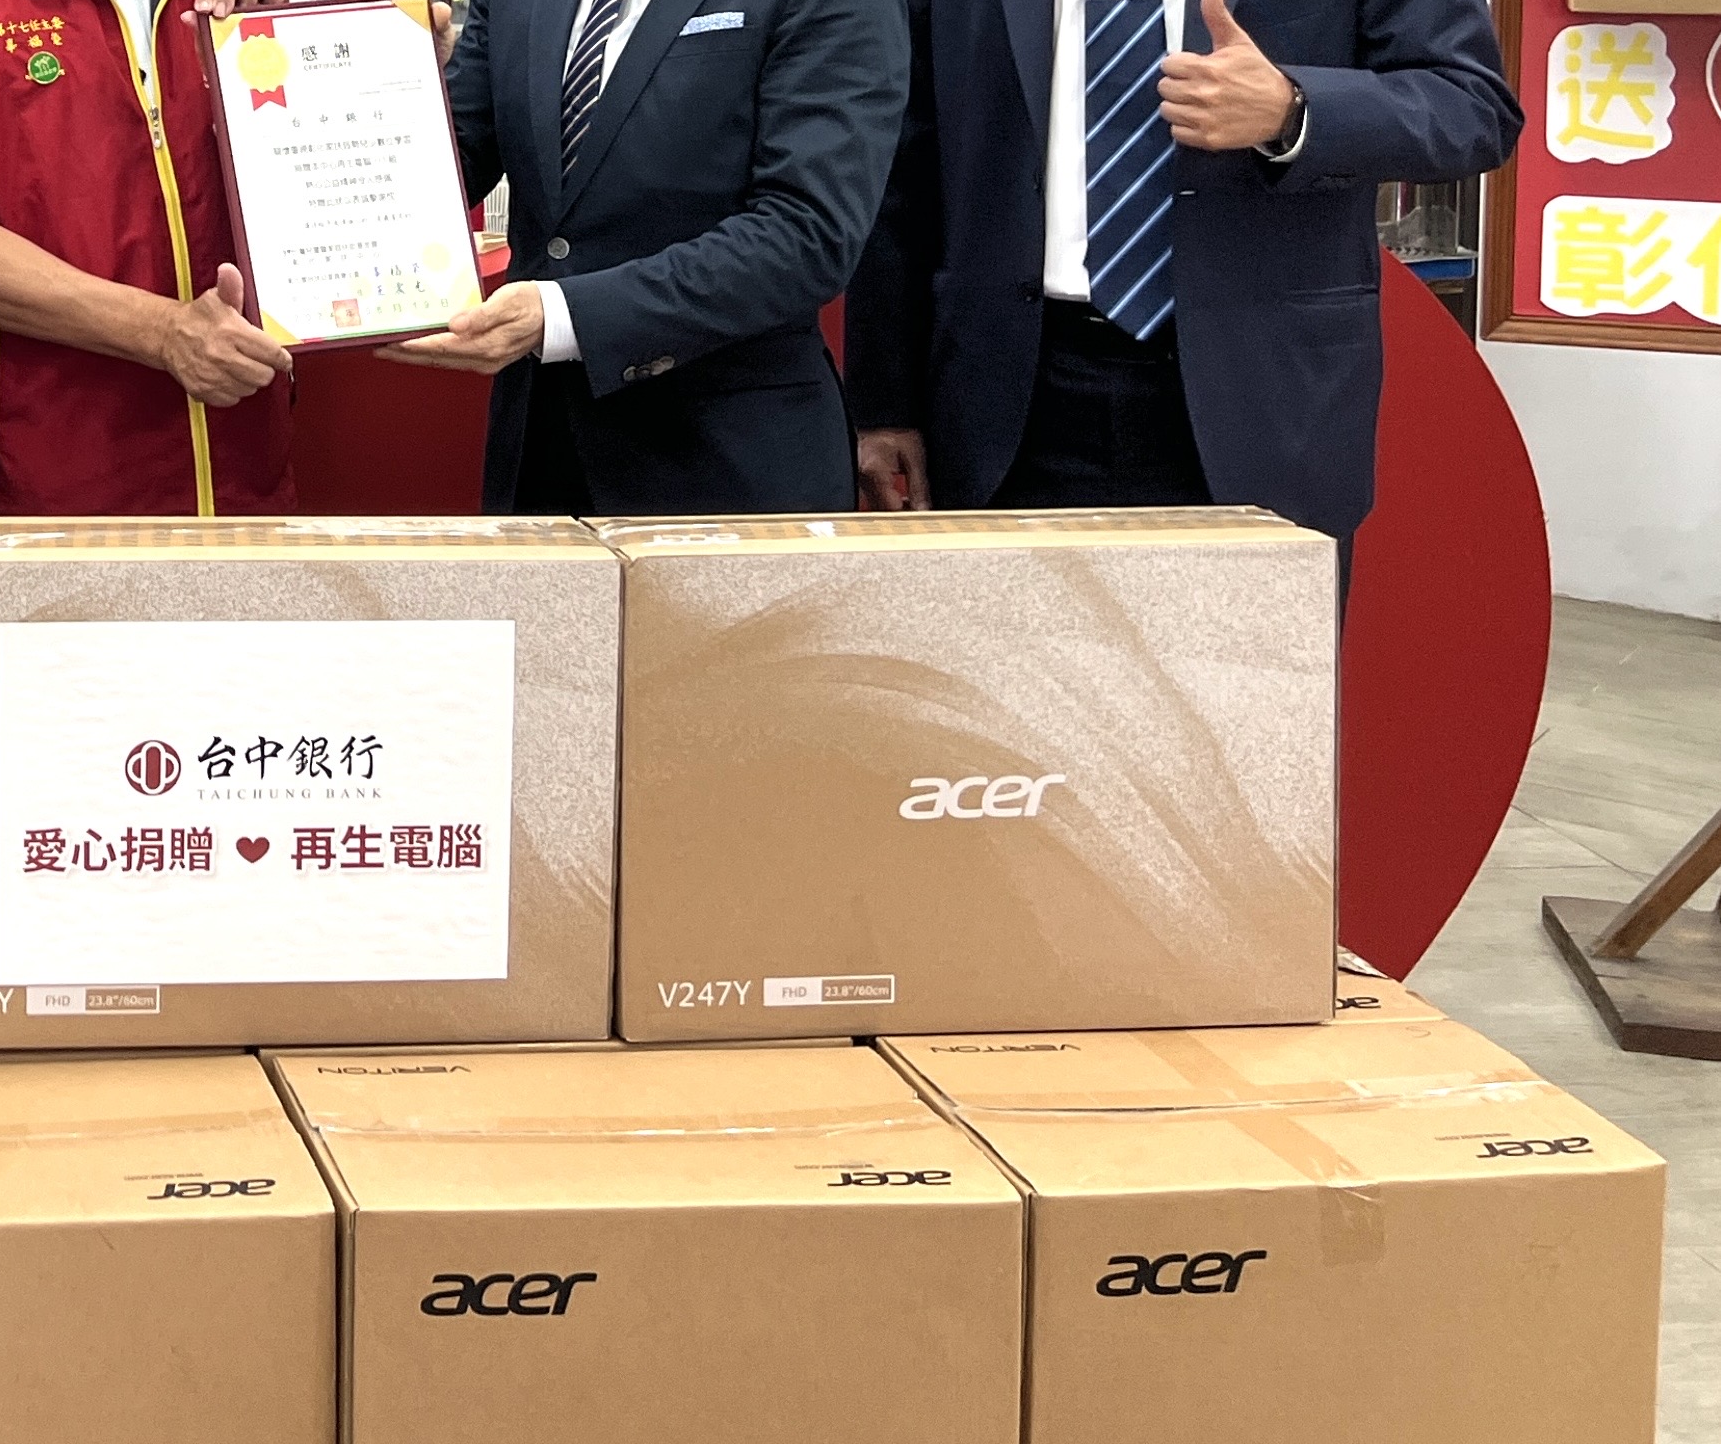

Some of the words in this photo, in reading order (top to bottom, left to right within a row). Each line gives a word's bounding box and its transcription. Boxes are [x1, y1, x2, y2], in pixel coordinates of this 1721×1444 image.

[1556, 30, 1656, 148] 送
[197, 735, 384, 780] 台中銀行
[197, 787, 312, 801] TAICHUNG
[326, 787, 383, 800] BANK
[899, 774, 1065, 820] acer
[22, 827, 213, 873] 愛心捐贈
[291, 824, 483, 870] 再生電腦
[45, 994, 70, 1007] FHD
[658, 980, 751, 1008] V247Y
[782, 986, 807, 999] FHD
[1476, 1137, 1594, 1158] acer
[147, 1179, 276, 1200] acer
[827, 1170, 951, 1187] acer
[1096, 1249, 1267, 1297] acer
[419, 1272, 597, 1316] acer
